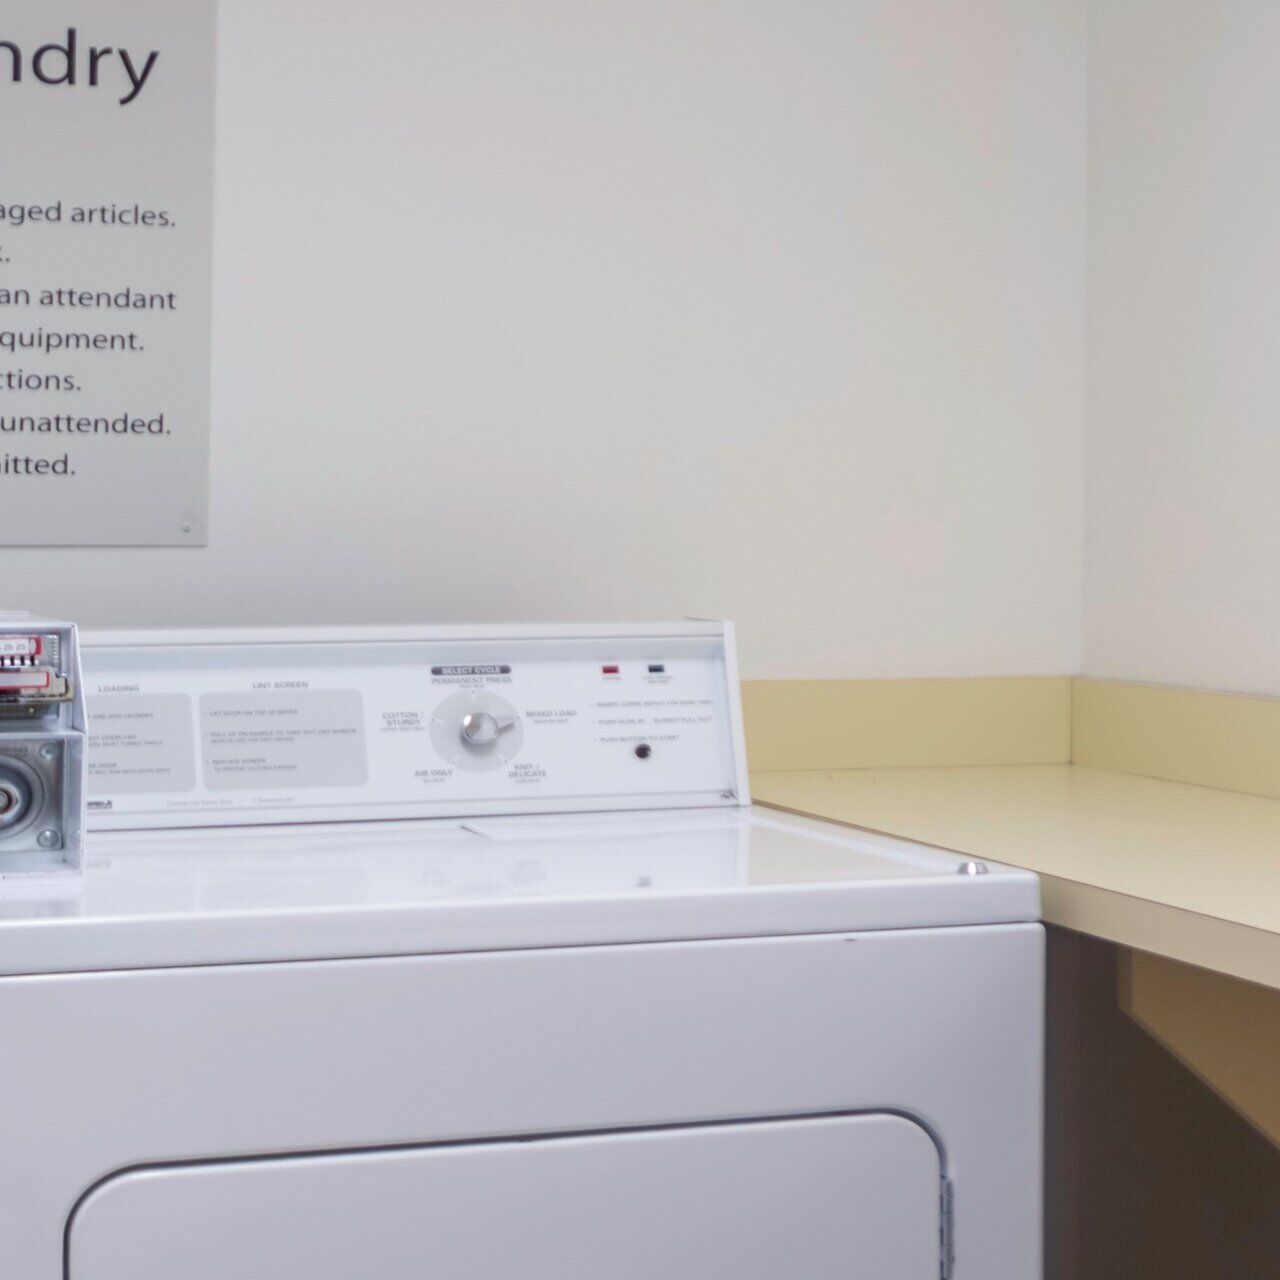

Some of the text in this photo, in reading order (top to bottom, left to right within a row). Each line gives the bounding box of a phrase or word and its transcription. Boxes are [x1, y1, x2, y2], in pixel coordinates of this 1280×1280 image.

[72, 205, 175, 226] articles.
[40, 288, 175, 309] attendant
[1, 414, 171, 434] unattended.
[432, 676, 512, 685] PERMANENT PRESS
[98, 684, 139, 692] LOADING
[430, 769, 453, 777] ONLY
[509, 770, 547, 778] DELICATE
